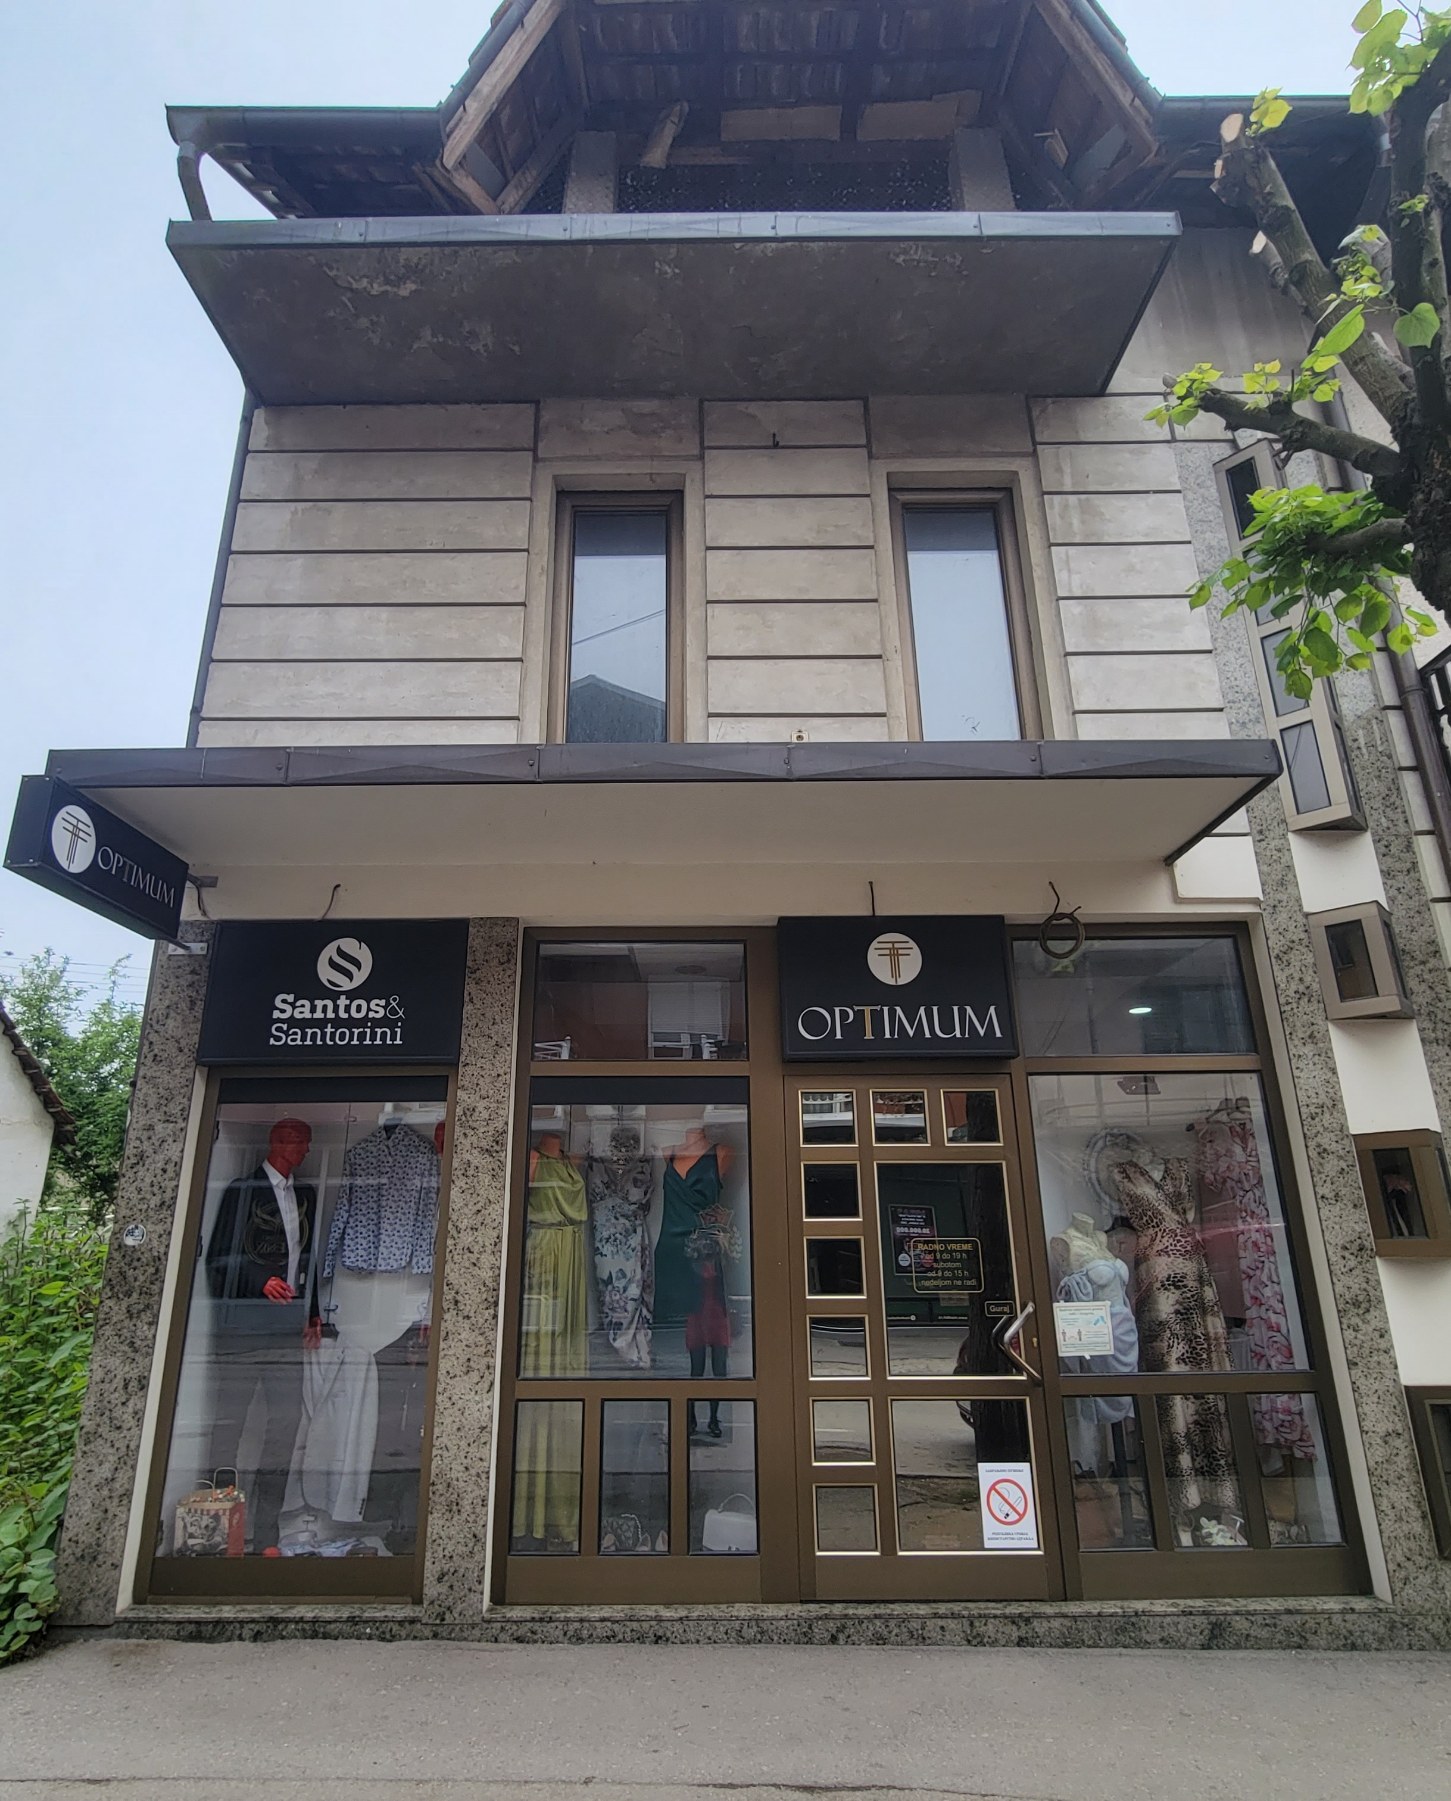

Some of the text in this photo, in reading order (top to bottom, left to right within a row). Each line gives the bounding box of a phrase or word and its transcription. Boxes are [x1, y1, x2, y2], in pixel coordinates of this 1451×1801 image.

[97, 846, 175, 908] OPTIMUM
[269, 1022, 403, 1046] Santorini
[797, 1004, 1003, 1040] OPTIMUM
[921, 1279, 952, 1287] nedeljom
[989, 1305, 1010, 1314] Guraj
